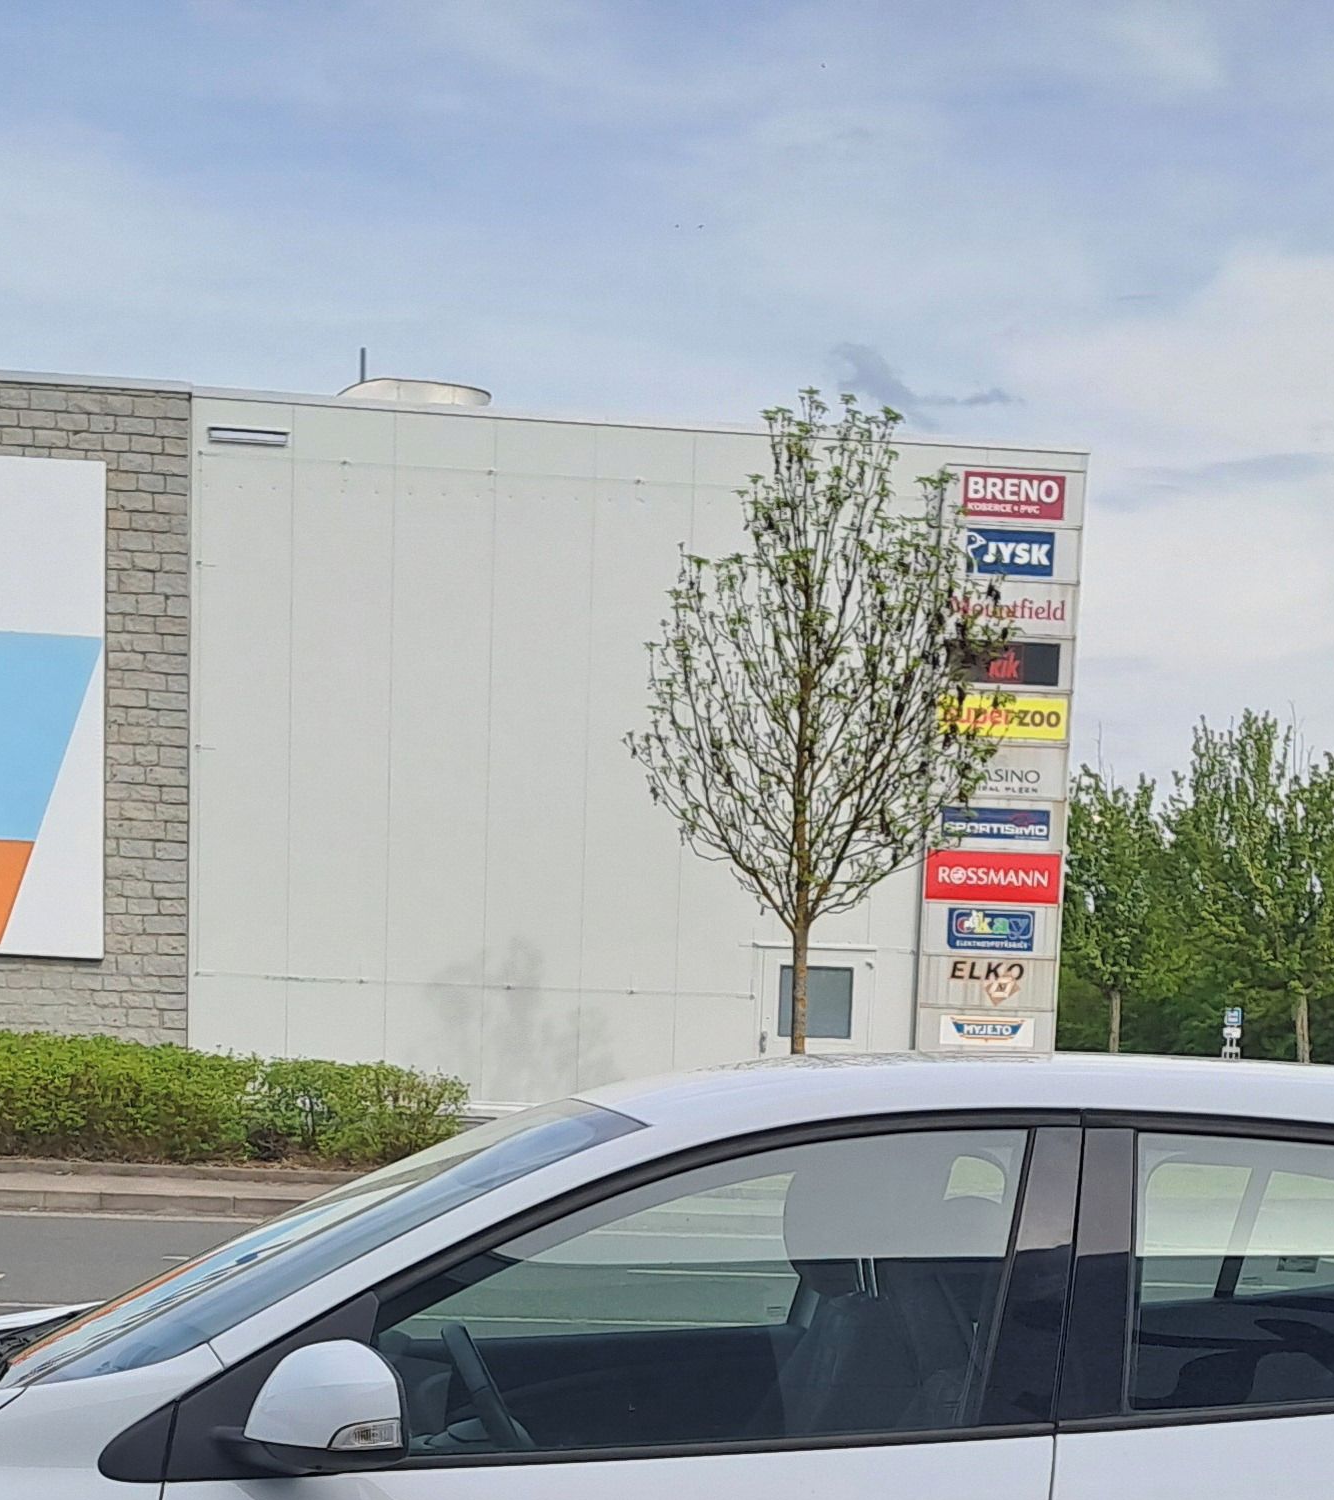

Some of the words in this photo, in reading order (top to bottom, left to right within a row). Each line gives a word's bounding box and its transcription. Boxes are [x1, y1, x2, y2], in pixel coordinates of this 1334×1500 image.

[967, 476, 1060, 503] BRENO
[1019, 504, 1041, 515] PVC
[983, 541, 1052, 566] JYSK
[948, 597, 1066, 622] Mountfield
[983, 768, 1042, 784] ASINO
[937, 866, 1049, 888] ROSSMANN
[950, 960, 1025, 981] ELKO
